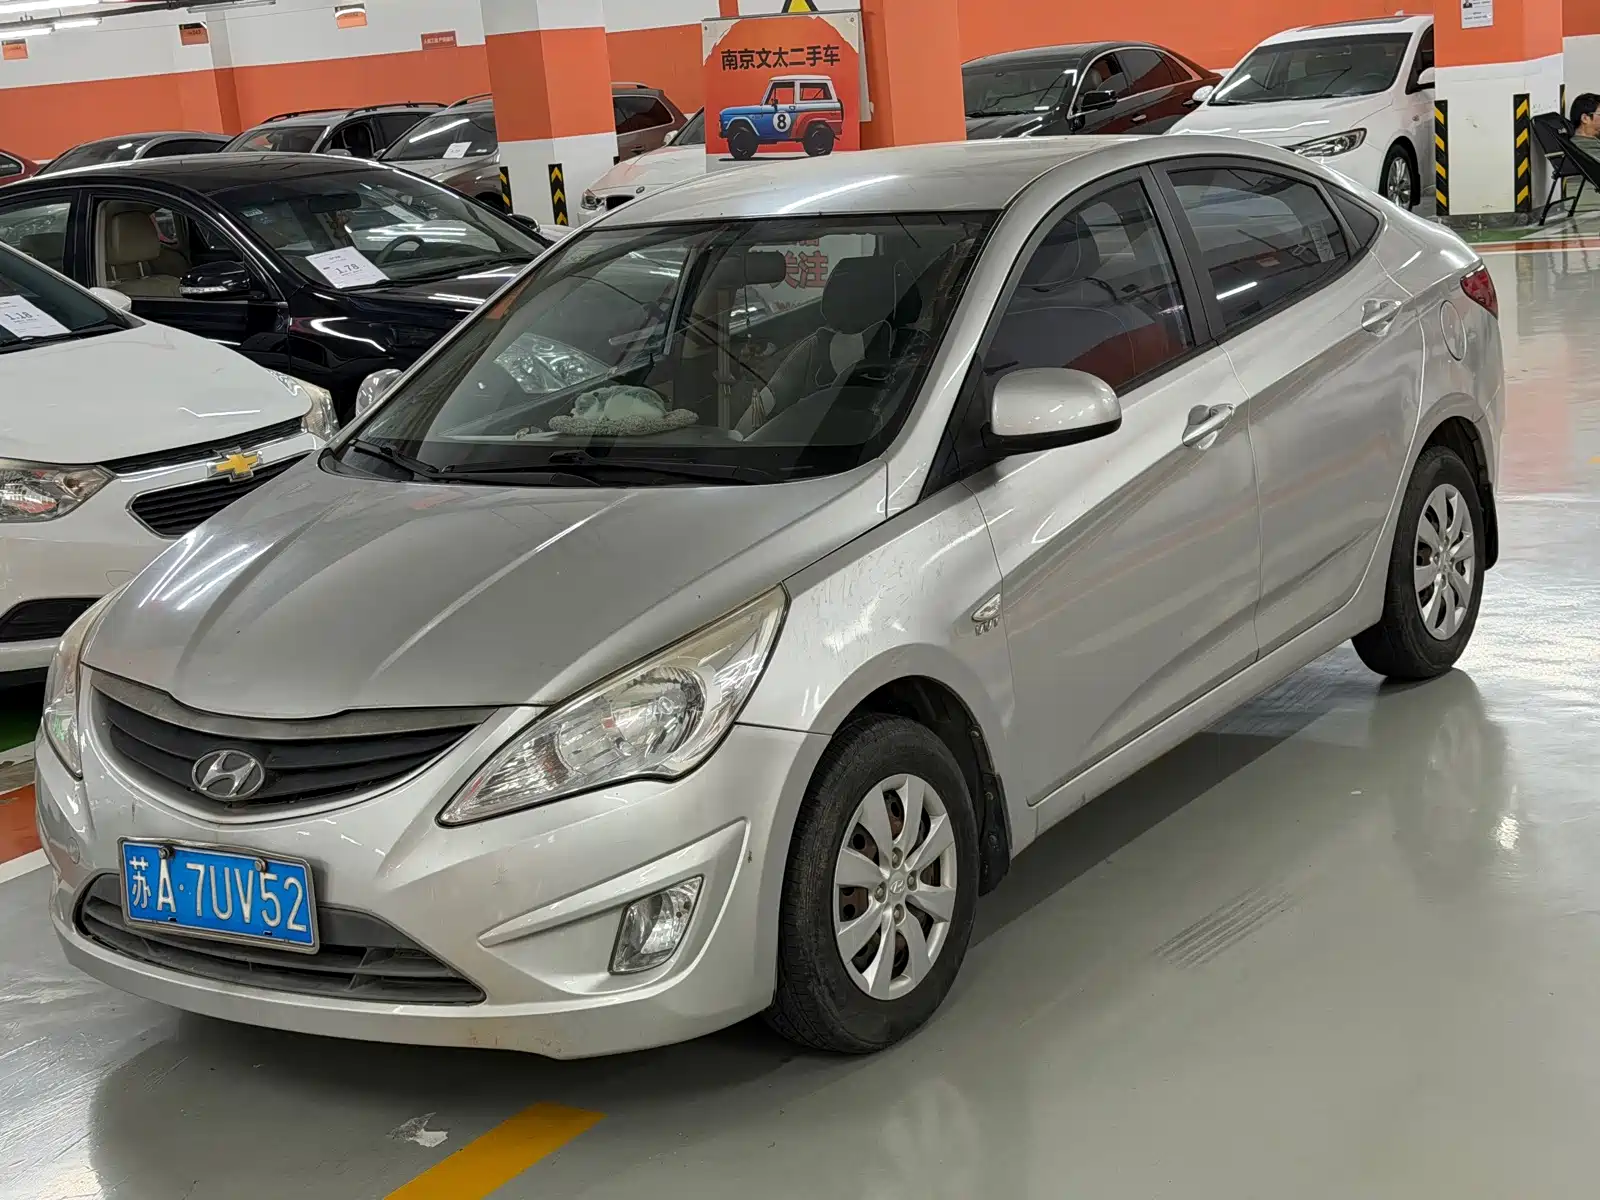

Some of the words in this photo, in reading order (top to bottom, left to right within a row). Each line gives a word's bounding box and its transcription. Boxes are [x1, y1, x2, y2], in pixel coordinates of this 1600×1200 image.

[721, 44, 840, 71] 南京文太二手车
[777, 114, 787, 130] 8
[335, 263, 360, 274] 1.78
[4, 311, 33, 321] 1.18
[129, 856, 307, 932] 苏A·7UV52
